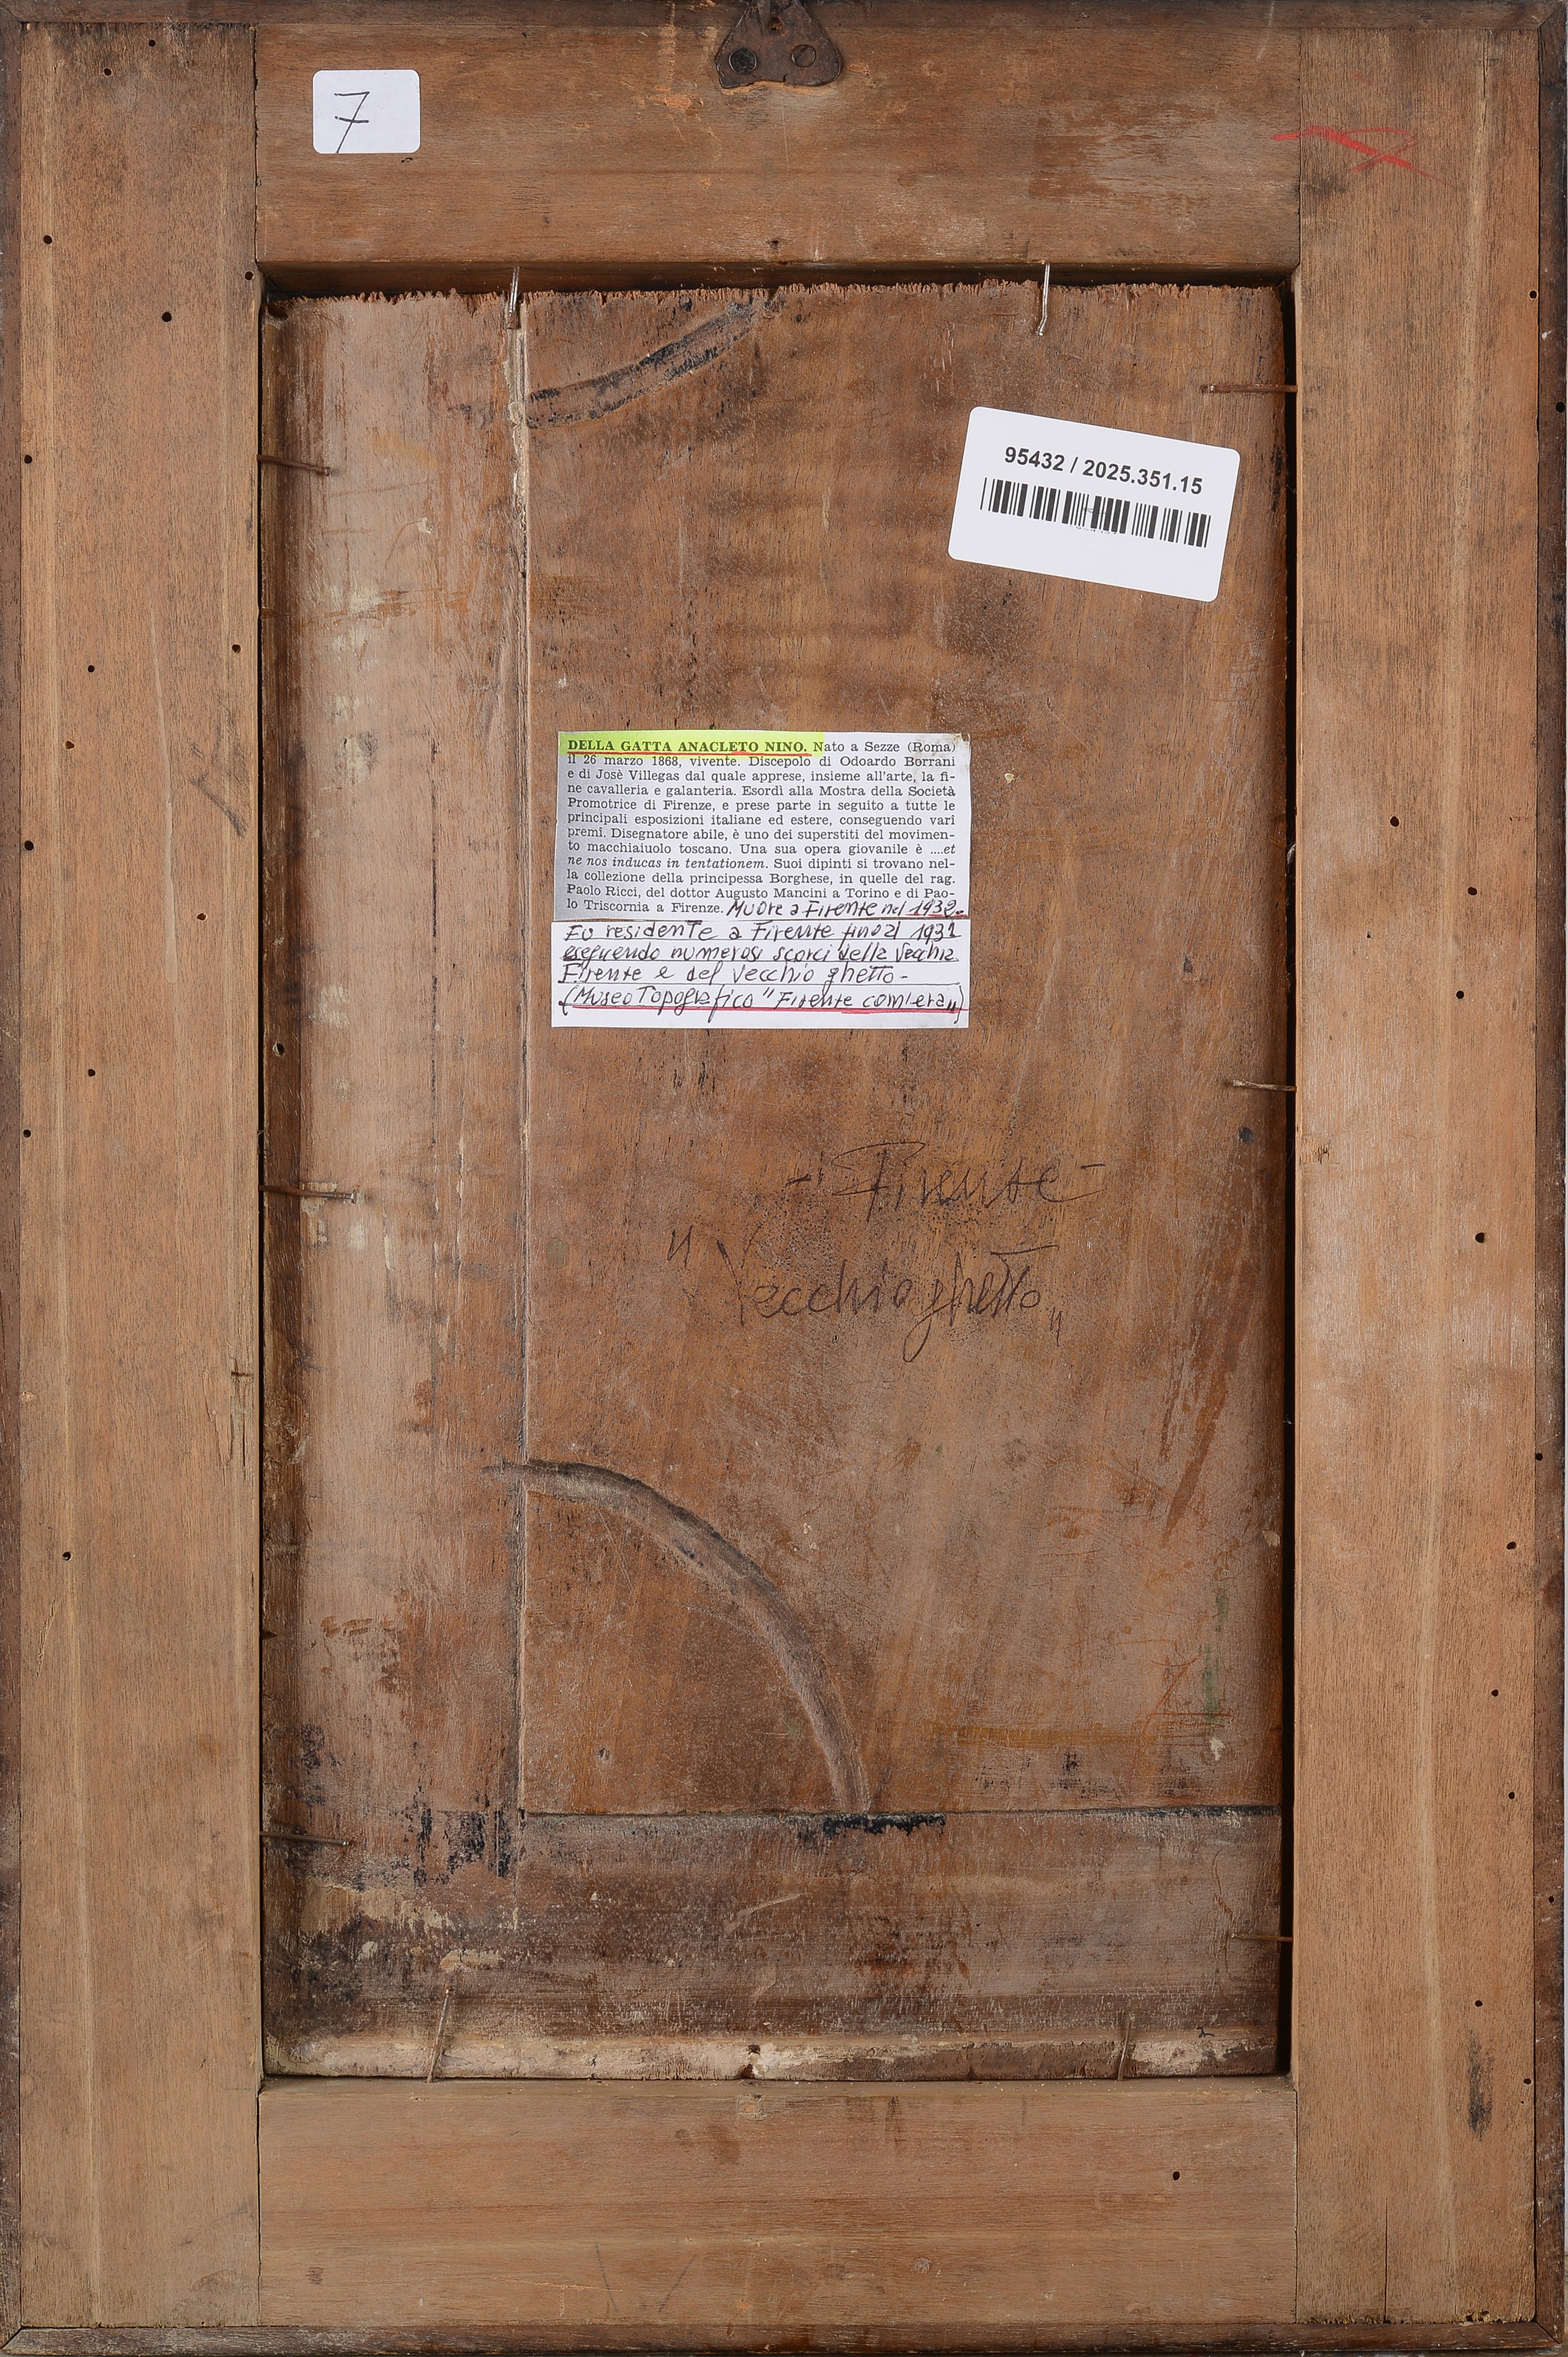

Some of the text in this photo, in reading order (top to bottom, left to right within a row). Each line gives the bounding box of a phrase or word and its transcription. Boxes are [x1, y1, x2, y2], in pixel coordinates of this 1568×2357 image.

[334, 91, 369, 153] 7
[1005, 445, 1203, 495] 95432 / 2025.351.15
[568, 740, 615, 751] DELLA
[620, 741, 672, 752] GATTA
[678, 741, 758, 752] ANACLETO
[765, 742, 807, 752] NINO.
[813, 741, 844, 752] Nato
[864, 741, 900, 752] Sezze
[907, 742, 955, 753] (Roma)
[567, 754, 956, 768] il 26 marzo 1868, vivente. Discepolo di Odoardo Borrani
[567, 770, 574, 778] e
[579, 768, 591, 779] di
[628, 770, 679, 783] Villegas
[685, 771, 705, 781] dal
[711, 771, 746, 783] quale
[752, 773, 805, 783] apprese,
[811, 771, 860, 781] insieme
[866, 771, 916, 783] all'arte,
[922, 771, 935, 782] la
[940, 771, 955, 782] fi-
[567, 784, 956, 797] ne cavalleria e galanteria. Esordì alla Mostra della Società
[567, 797, 637, 810] Promotrice
[644, 800, 656, 810] di
[663, 800, 715, 812] Firenze,
[722, 802, 729, 810] e
[736, 802, 770, 813] prese
[777, 800, 811, 813] parte
[818, 800, 831, 810] in
[838, 800, 884, 813] seguito
[906, 800, 937, 811] tutte
[944, 800, 955, 811] le
[567, 811, 628, 826] principali
[635, 815, 704, 826] esposizioni
[711, 814, 761, 825] italiane
[768, 814, 784, 825] ed
[791, 814, 832, 826] estere,
[839, 815, 922, 827] conseguendo
[610, 828, 688, 841] Disegnatore
[693, 829, 728, 841] abile,
[732, 828, 740, 839] è
[744, 831, 769, 840] uno
[774, 829, 793, 840] dei
[797, 829, 859, 841] superstiti
[864, 829, 883, 840] del
[889, 829, 955, 840] movimen-
[568, 840, 580, 851] to
[587, 842, 671, 854] macchiaiuolo
[679, 843, 732, 854] toscano.
[740, 844, 767, 854] Una
[774, 846, 797, 854] sua
[804, 846, 841, 856] opera
[849, 844, 908, 856] giovanile
[916, 843, 922, 854] è
[567, 856, 955, 871] ne nos inducas in tentationem. Suoi dipinti si trovano nel-
[566, 869, 955, 886] la collezione della principessa Borghese, in quelle del rag.
[566, 884, 600, 896] Paolo
[605, 886, 641, 899] Ricci,
[646, 887, 665, 897] del
[670, 887, 710, 898] dottor
[715, 888, 768, 901] Augusto
[774, 888, 827, 898] Mancini
[845, 888, 889, 898] Torino
[894, 890, 901, 899] e
[906, 888, 919, 899] di
[924, 888, 955, 898] Pao-
[567, 897, 723, 913] lo Triscornia a Firenze.
[790, 903, 799, 916] a
[882, 900, 906, 916] nel
[606, 920, 718, 940] residente
[729, 927, 741, 940] a
[671, 944, 762, 962] numerosi
[773, 944, 833, 962] scorci
[839, 942, 887, 962] della
[659, 965, 674, 979] e
[687, 960, 723, 986] del
